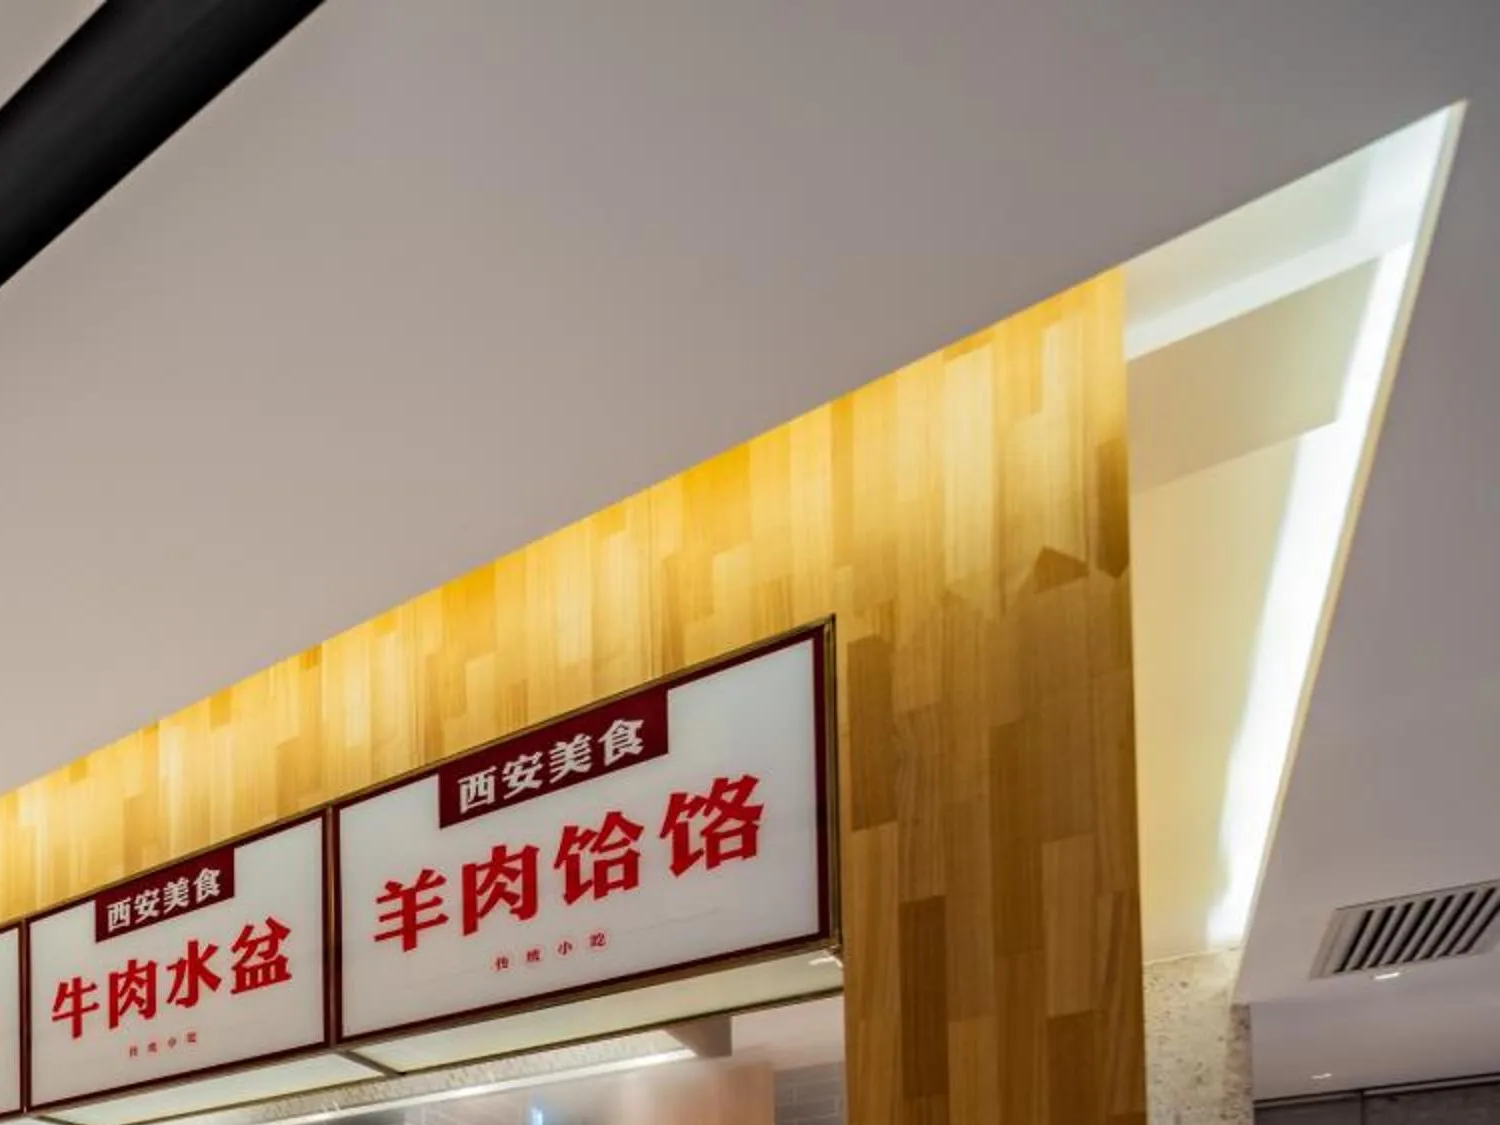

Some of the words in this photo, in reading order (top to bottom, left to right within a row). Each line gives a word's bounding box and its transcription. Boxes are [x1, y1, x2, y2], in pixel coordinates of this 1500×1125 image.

[458, 718, 644, 814] 西安美食
[107, 867, 221, 932] 西安美食
[374, 774, 765, 952] 羊肉饸饹
[51, 916, 292, 1039] 牛肉水盆
